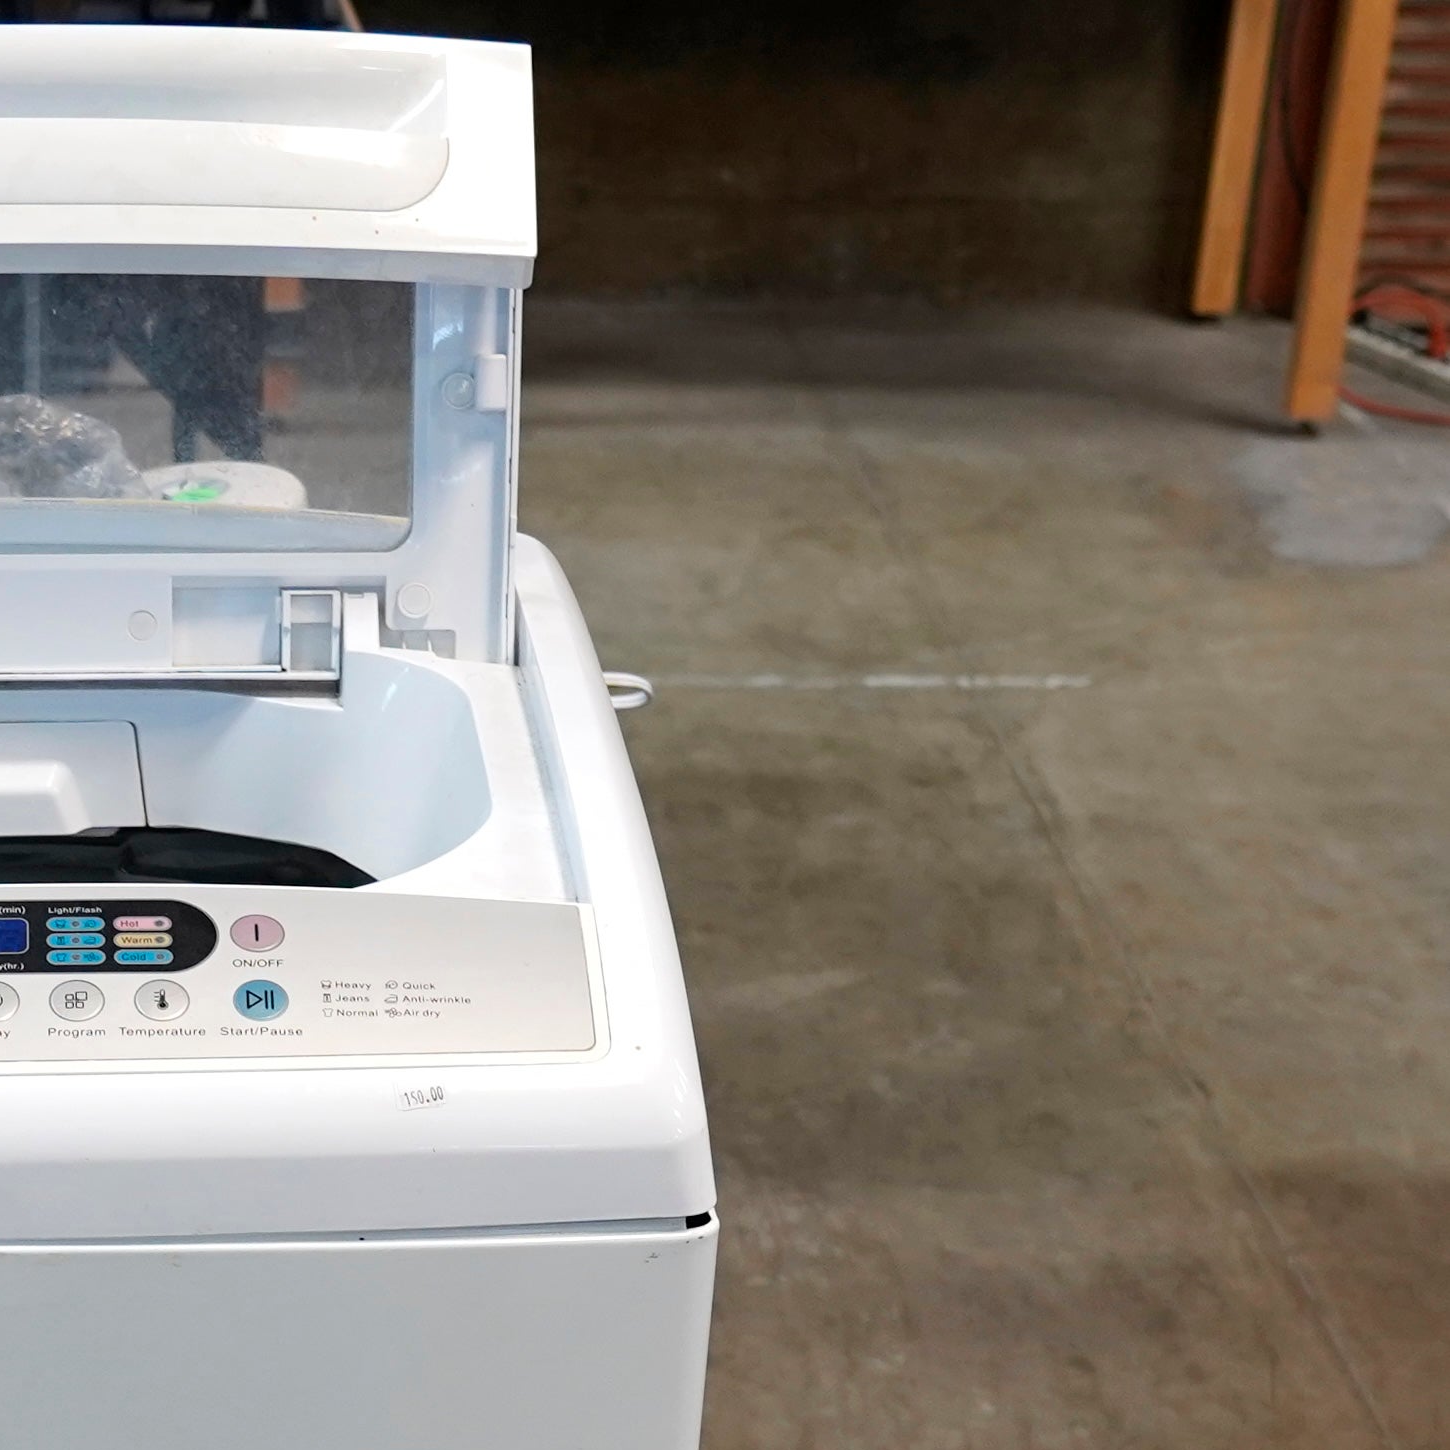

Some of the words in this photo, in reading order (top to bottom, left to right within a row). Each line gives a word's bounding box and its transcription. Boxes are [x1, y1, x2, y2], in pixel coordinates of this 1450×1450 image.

[48, 906, 103, 915] Light/Flash
[120, 920, 139, 928] Hot
[121, 936, 153, 944] Warm
[121, 953, 147, 961] Cold
[232, 958, 284, 968] ON/OFF
[335, 981, 372, 990] Heavy
[402, 981, 436, 990] Quick
[335, 994, 370, 1002] Jeans
[402, 995, 471, 1004] Anti-wrinkle
[336, 1009, 379, 1017] Normal
[403, 1009, 420, 1017] Air
[422, 1009, 441, 1018] dry
[47, 1027, 106, 1038] Program
[118, 1026, 206, 1038] Temperature
[220, 1026, 303, 1037] Start/Pause
